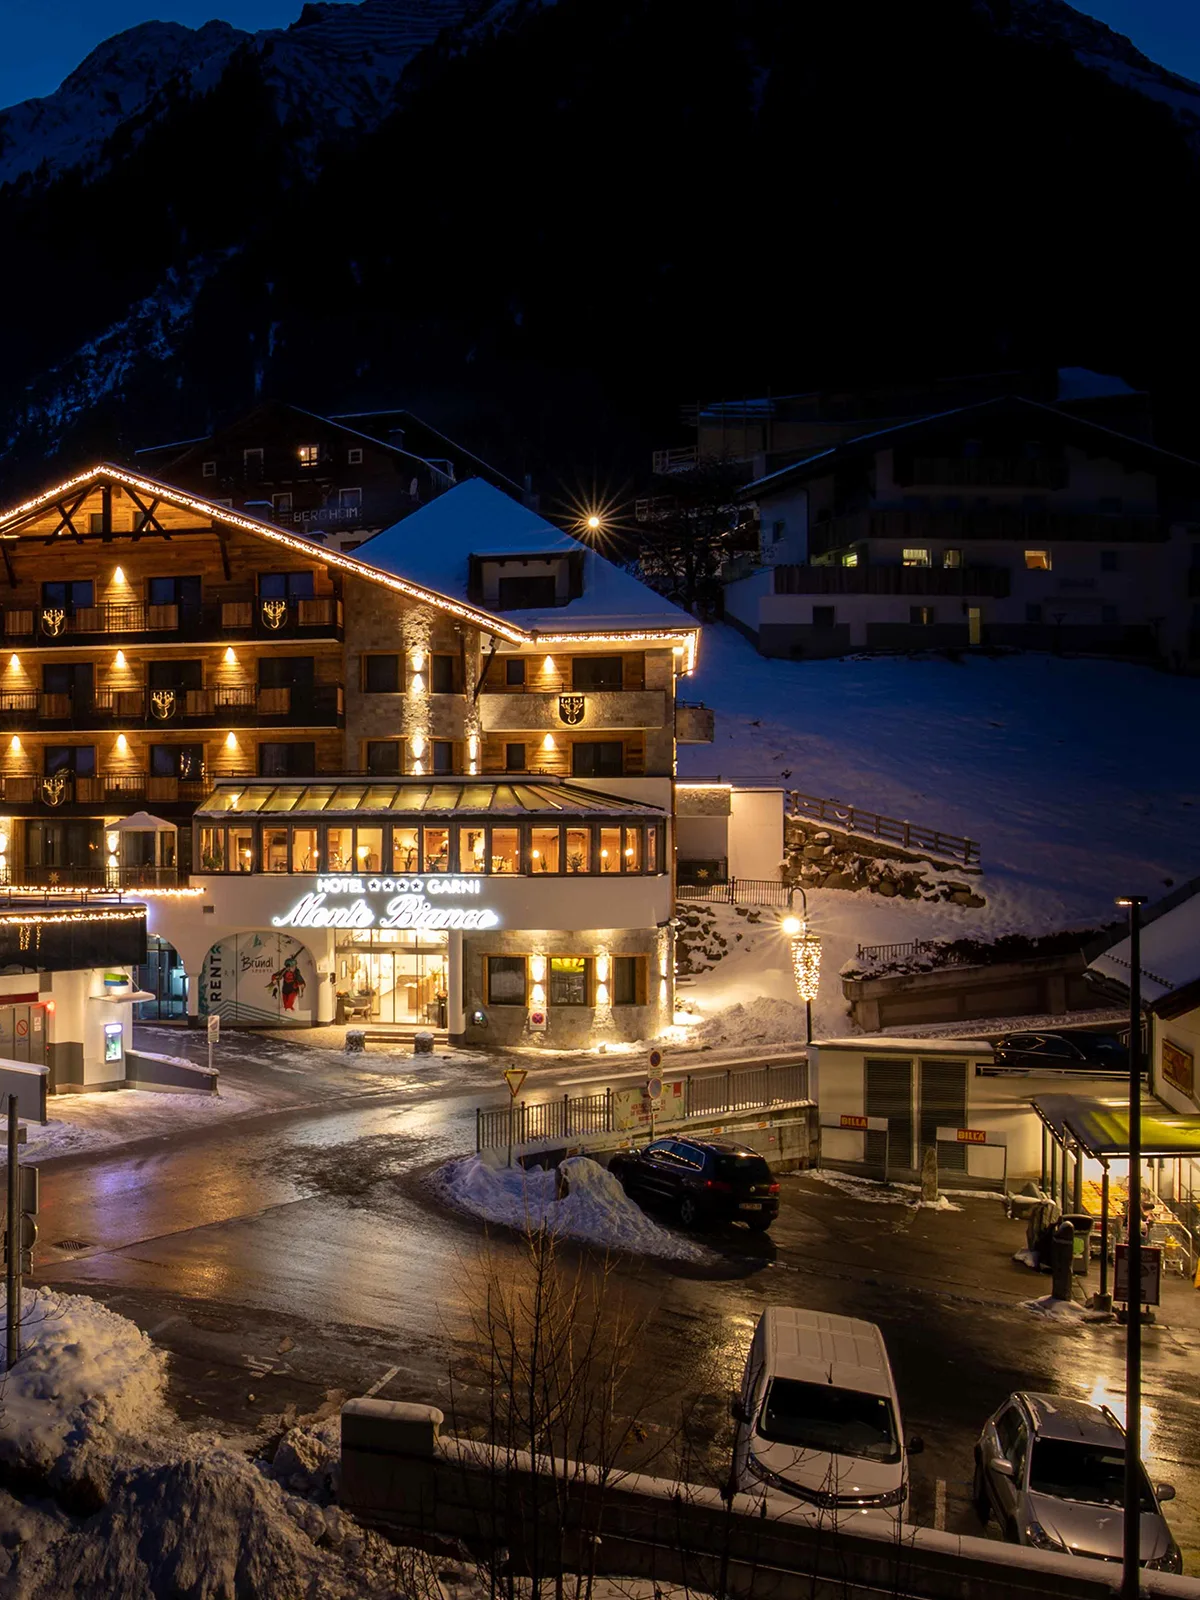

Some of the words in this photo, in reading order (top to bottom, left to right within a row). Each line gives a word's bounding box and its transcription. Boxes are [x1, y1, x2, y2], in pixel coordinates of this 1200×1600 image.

[316, 878, 366, 893] HOTEL
[427, 878, 481, 894] GARNI
[272, 892, 374, 928] Monte
[379, 893, 500, 929] Bianco
[210, 956, 222, 1002] RENT
[841, 1116, 867, 1127] BILLA
[958, 1131, 985, 1142] BILLA
